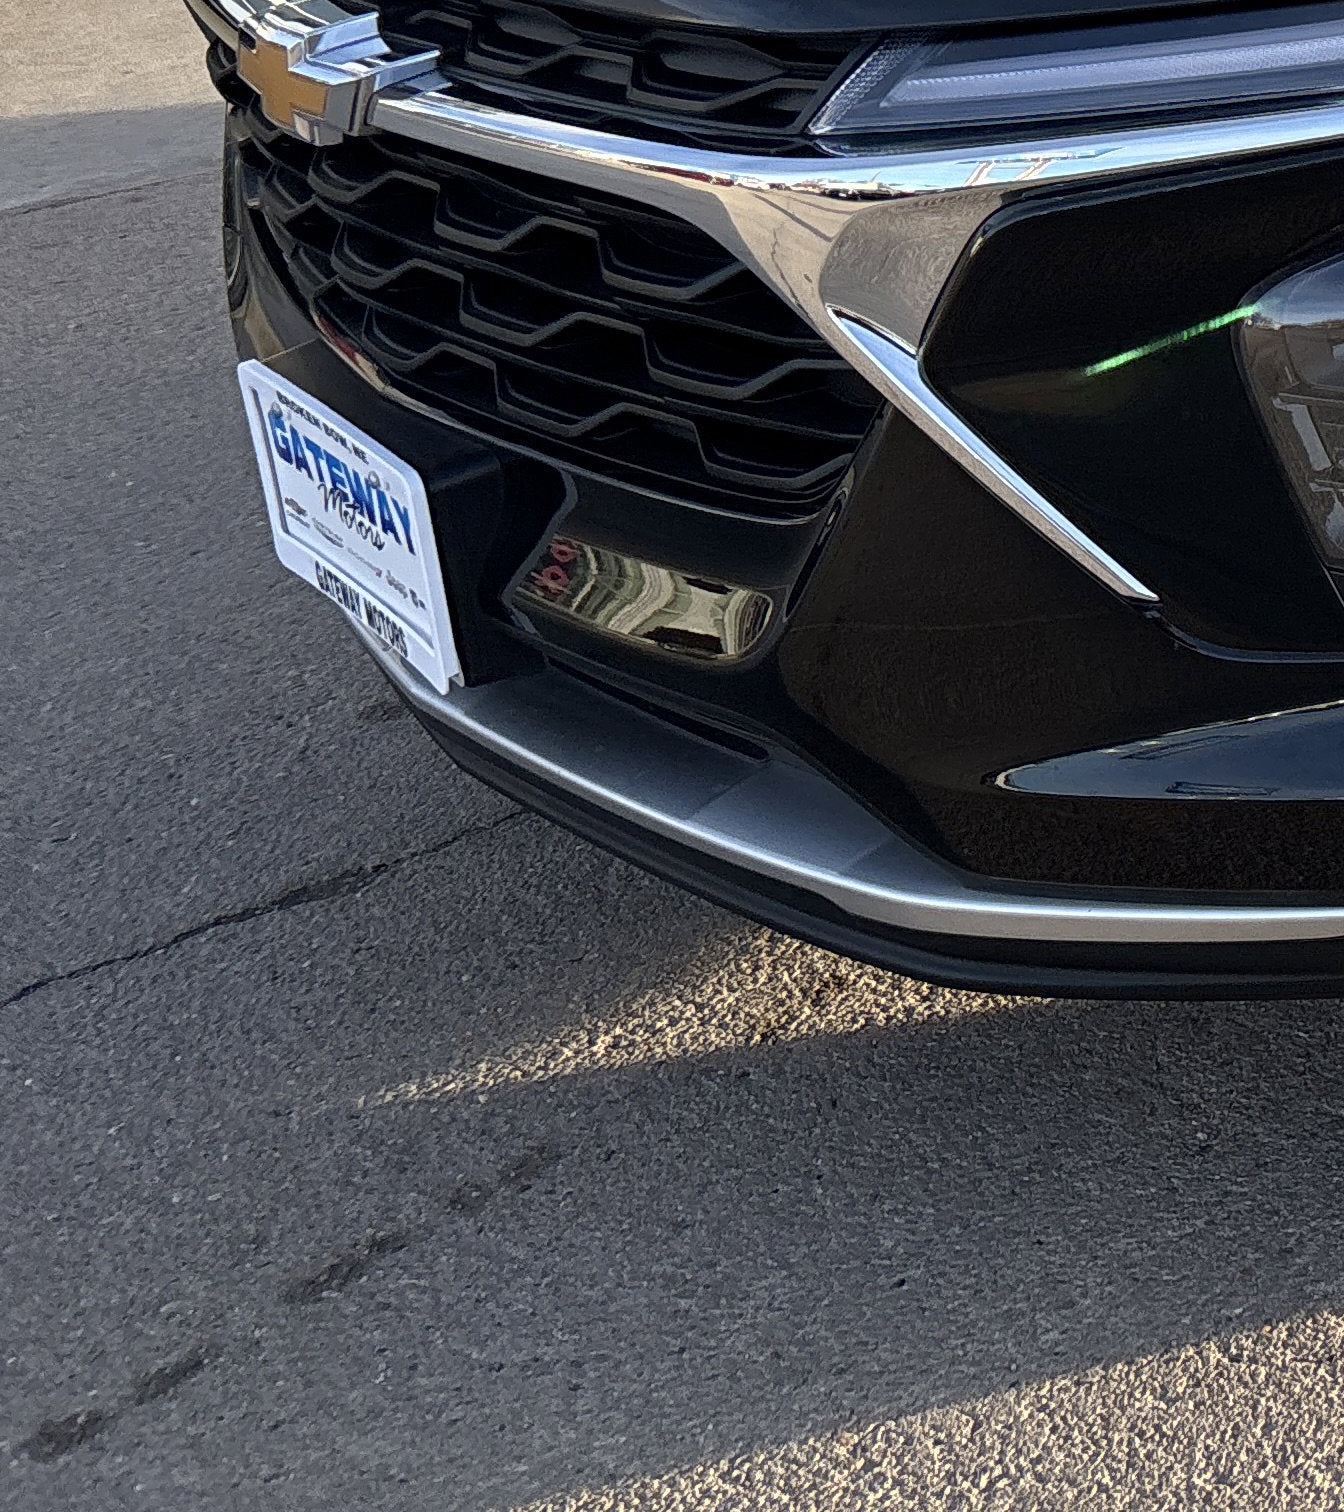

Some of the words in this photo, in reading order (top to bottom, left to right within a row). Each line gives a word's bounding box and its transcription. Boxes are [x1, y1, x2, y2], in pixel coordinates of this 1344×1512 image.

[276, 390, 322, 430] BROKEN
[267, 406, 417, 557] GATEWAY
[317, 483, 386, 551] Motors
[314, 560, 362, 620] GATEWAY
[362, 597, 409, 659] MOTORS
